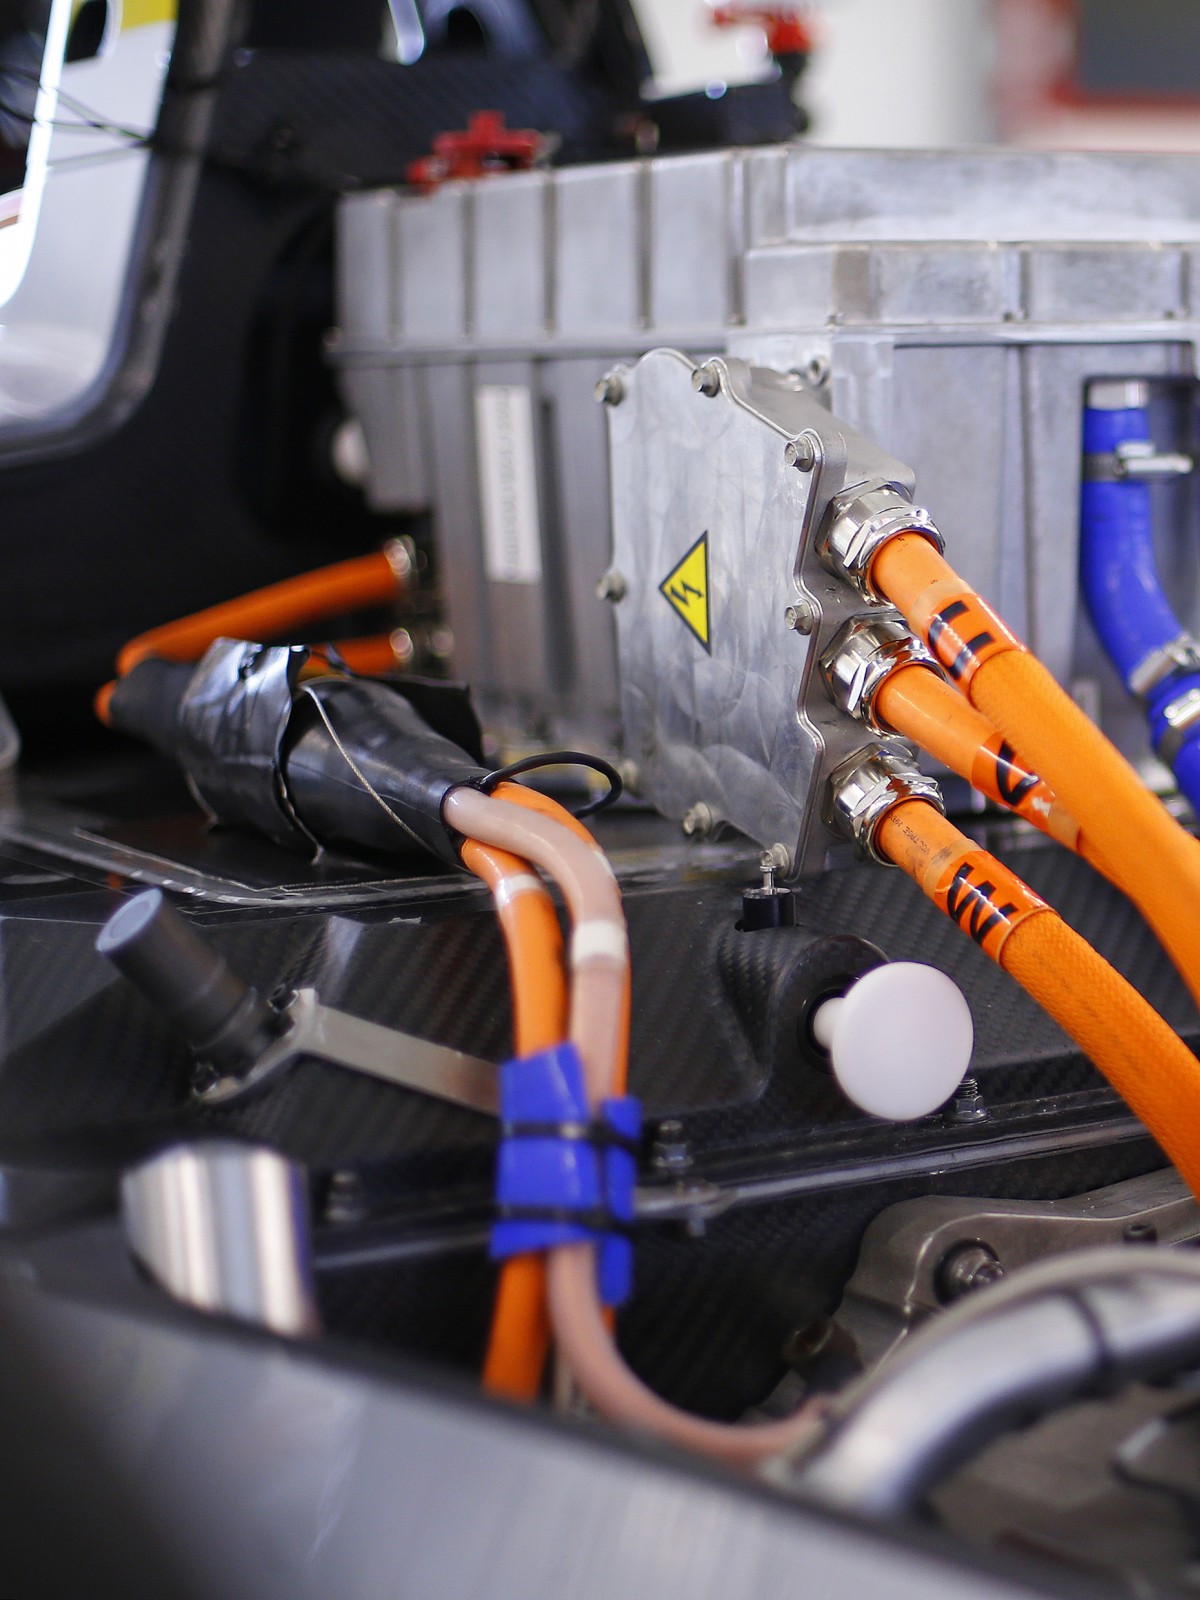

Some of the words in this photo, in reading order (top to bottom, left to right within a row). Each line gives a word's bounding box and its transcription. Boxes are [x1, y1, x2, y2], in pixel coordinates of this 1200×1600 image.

[928, 600, 995, 681] U
[996, 737, 1040, 807] V
[947, 862, 1019, 945] W
